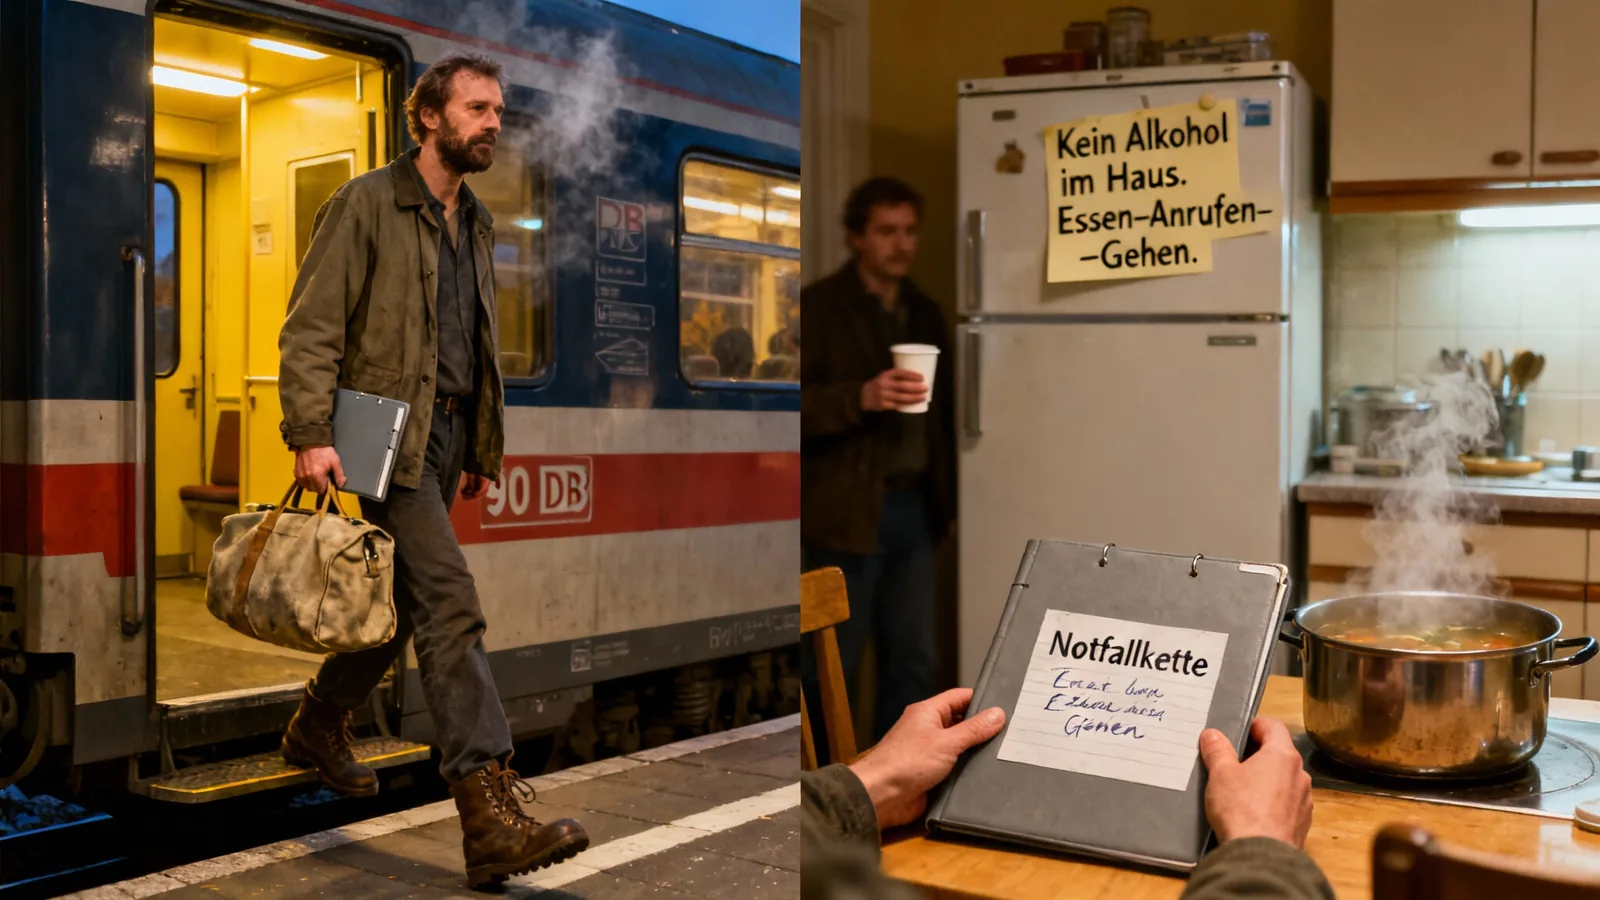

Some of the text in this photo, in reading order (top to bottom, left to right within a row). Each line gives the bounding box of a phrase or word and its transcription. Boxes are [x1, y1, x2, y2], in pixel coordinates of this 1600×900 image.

[1057, 111, 1228, 159] Kein Alkohol
[1061, 162, 1187, 197] im Haus.
[542, 467, 586, 512] DB
[1049, 630, 1209, 677] Notfallkette
